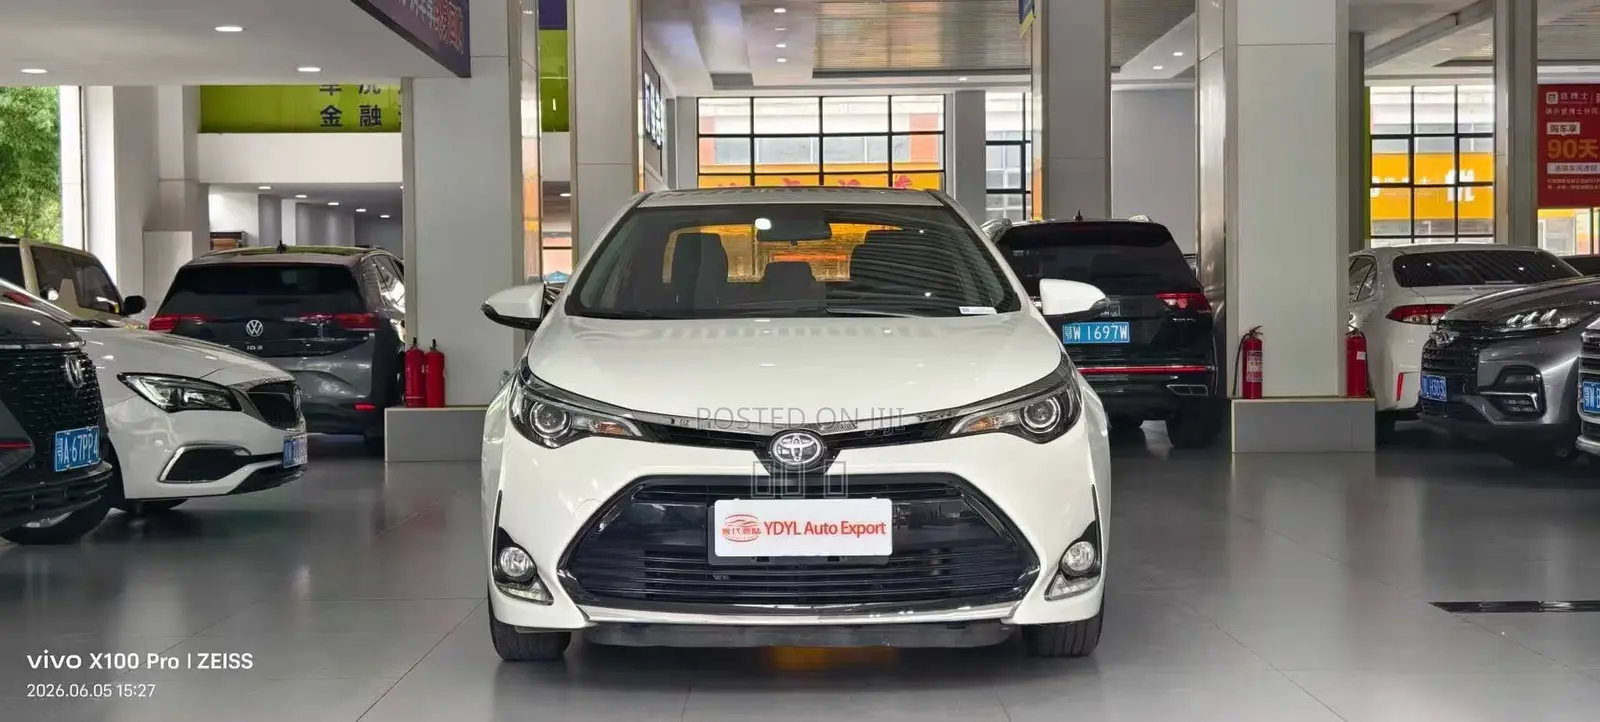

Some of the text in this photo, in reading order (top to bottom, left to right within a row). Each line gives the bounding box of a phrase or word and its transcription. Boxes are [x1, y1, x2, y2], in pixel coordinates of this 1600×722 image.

[1547, 139, 1598, 159] 90天
[764, 521, 801, 535] YDYL
[804, 521, 838, 535] Auto
[841, 521, 887, 538] Export
